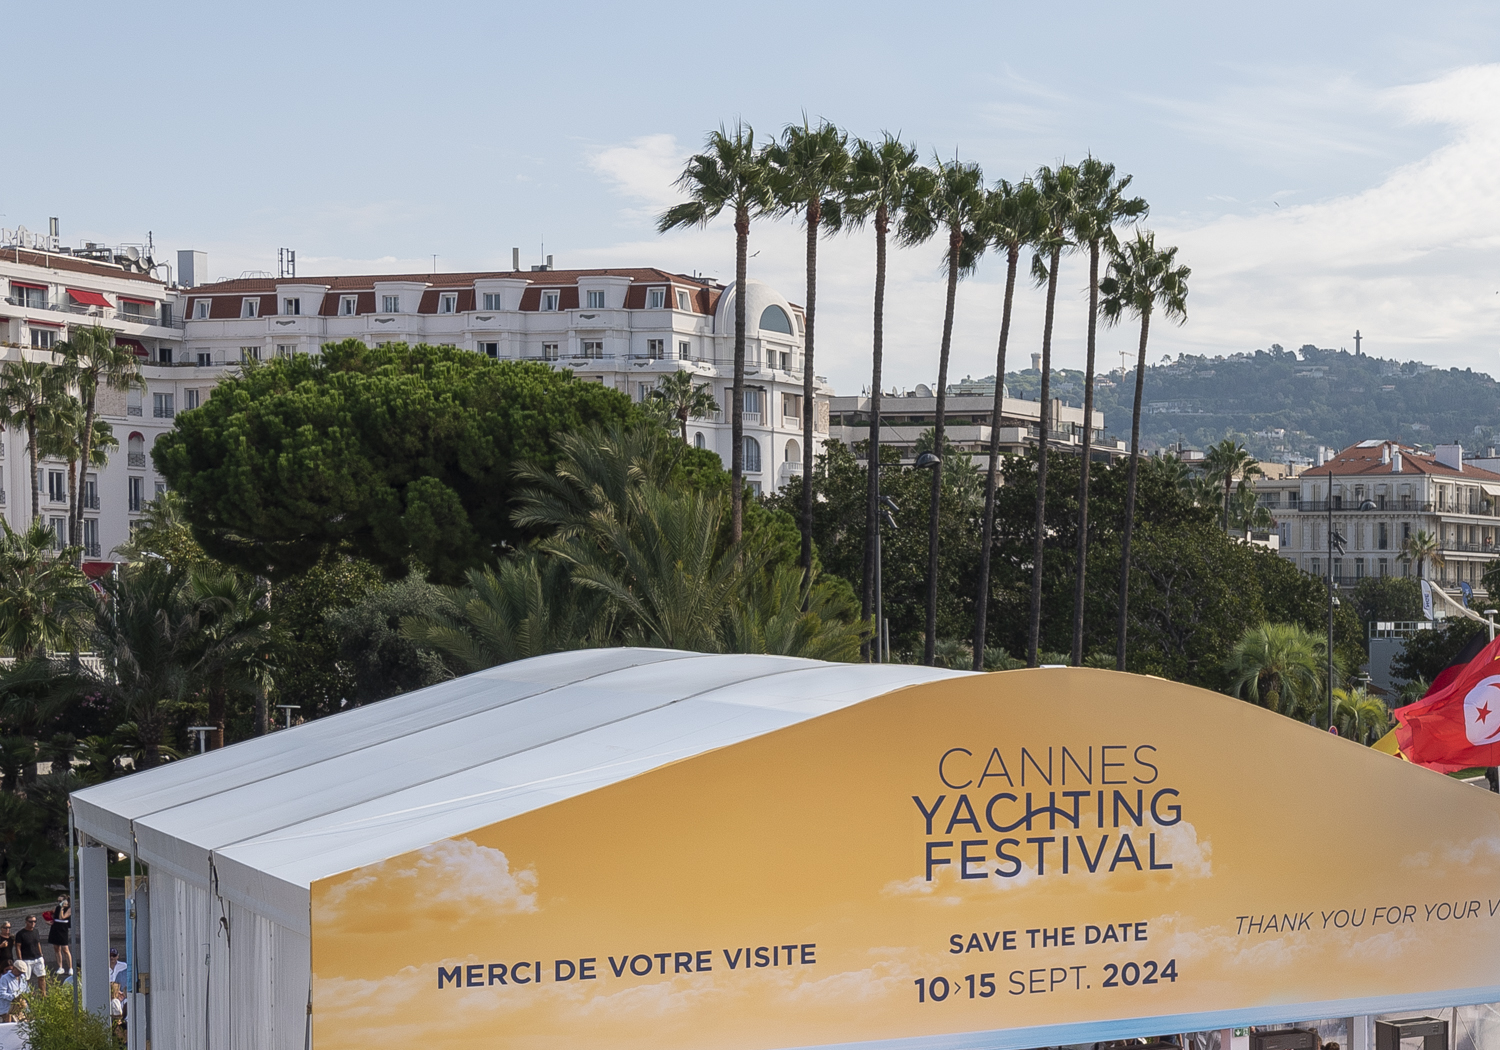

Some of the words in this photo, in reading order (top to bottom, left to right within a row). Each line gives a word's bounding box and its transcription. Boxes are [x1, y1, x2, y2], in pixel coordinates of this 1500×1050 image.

[938, 744, 1159, 790] CANNES
[911, 788, 1182, 836] YACHTING
[925, 833, 1174, 882] FESTIVAL
[949, 930, 1017, 954] SAVE
[1025, 926, 1076, 949] THE
[1084, 921, 1148, 945] DATE
[1235, 911, 1314, 935] THANK
[1320, 908, 1366, 929] YOU
[1371, 905, 1417, 926] FOR
[1424, 900, 1481, 922] YOUR
[437, 961, 542, 990] MERCI
[554, 957, 597, 982] DE
[608, 950, 713, 978] VOTRE
[722, 943, 817, 969] VISITE
[1008, 965, 1091, 996] SEPT.
[1102, 958, 1179, 988] 2024
